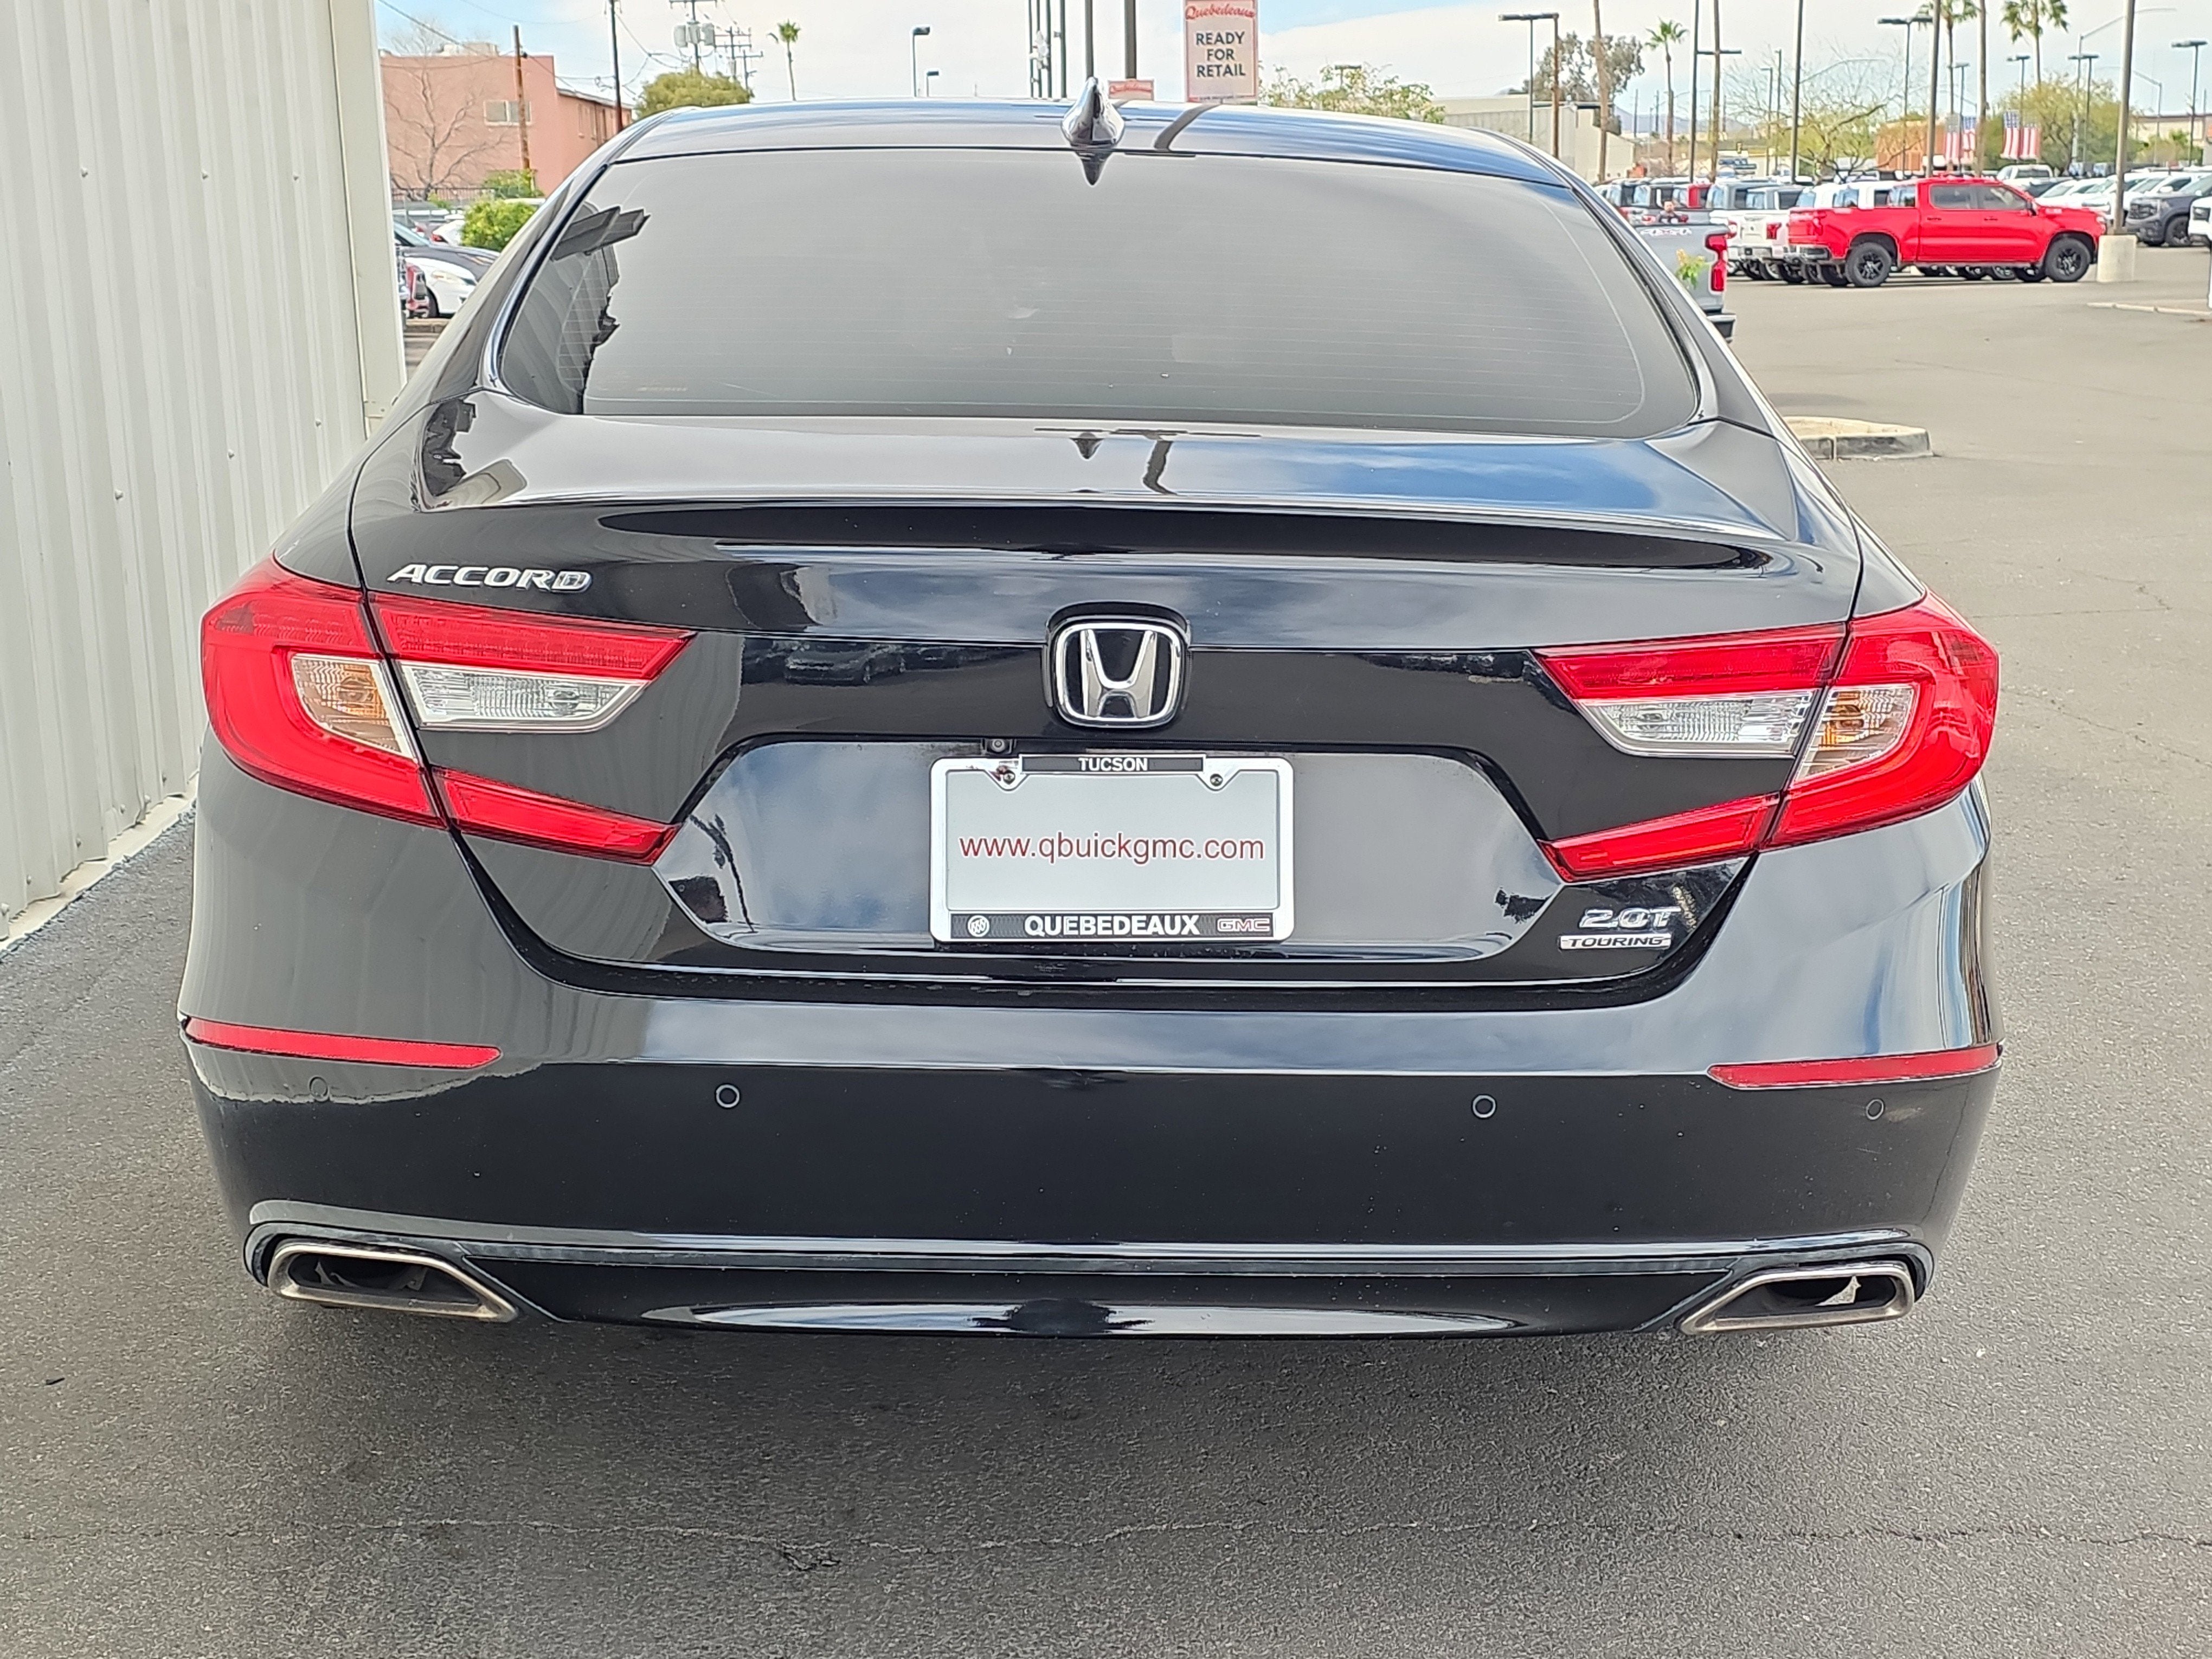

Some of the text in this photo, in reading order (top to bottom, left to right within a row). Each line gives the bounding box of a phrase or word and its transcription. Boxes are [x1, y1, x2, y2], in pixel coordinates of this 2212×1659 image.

[1196, 31, 1245, 45] READY
[1206, 49, 1234, 61] FOR
[1197, 63, 1246, 77] RETAIL
[386, 563, 593, 593] ACCORD
[1078, 757, 1148, 771] TUCSON
[959, 832, 1264, 864] www.qbuickgmc.com
[1024, 915, 1270, 937] QUEBEDEAUX GMC
[1568, 936, 1664, 948] TOURING
